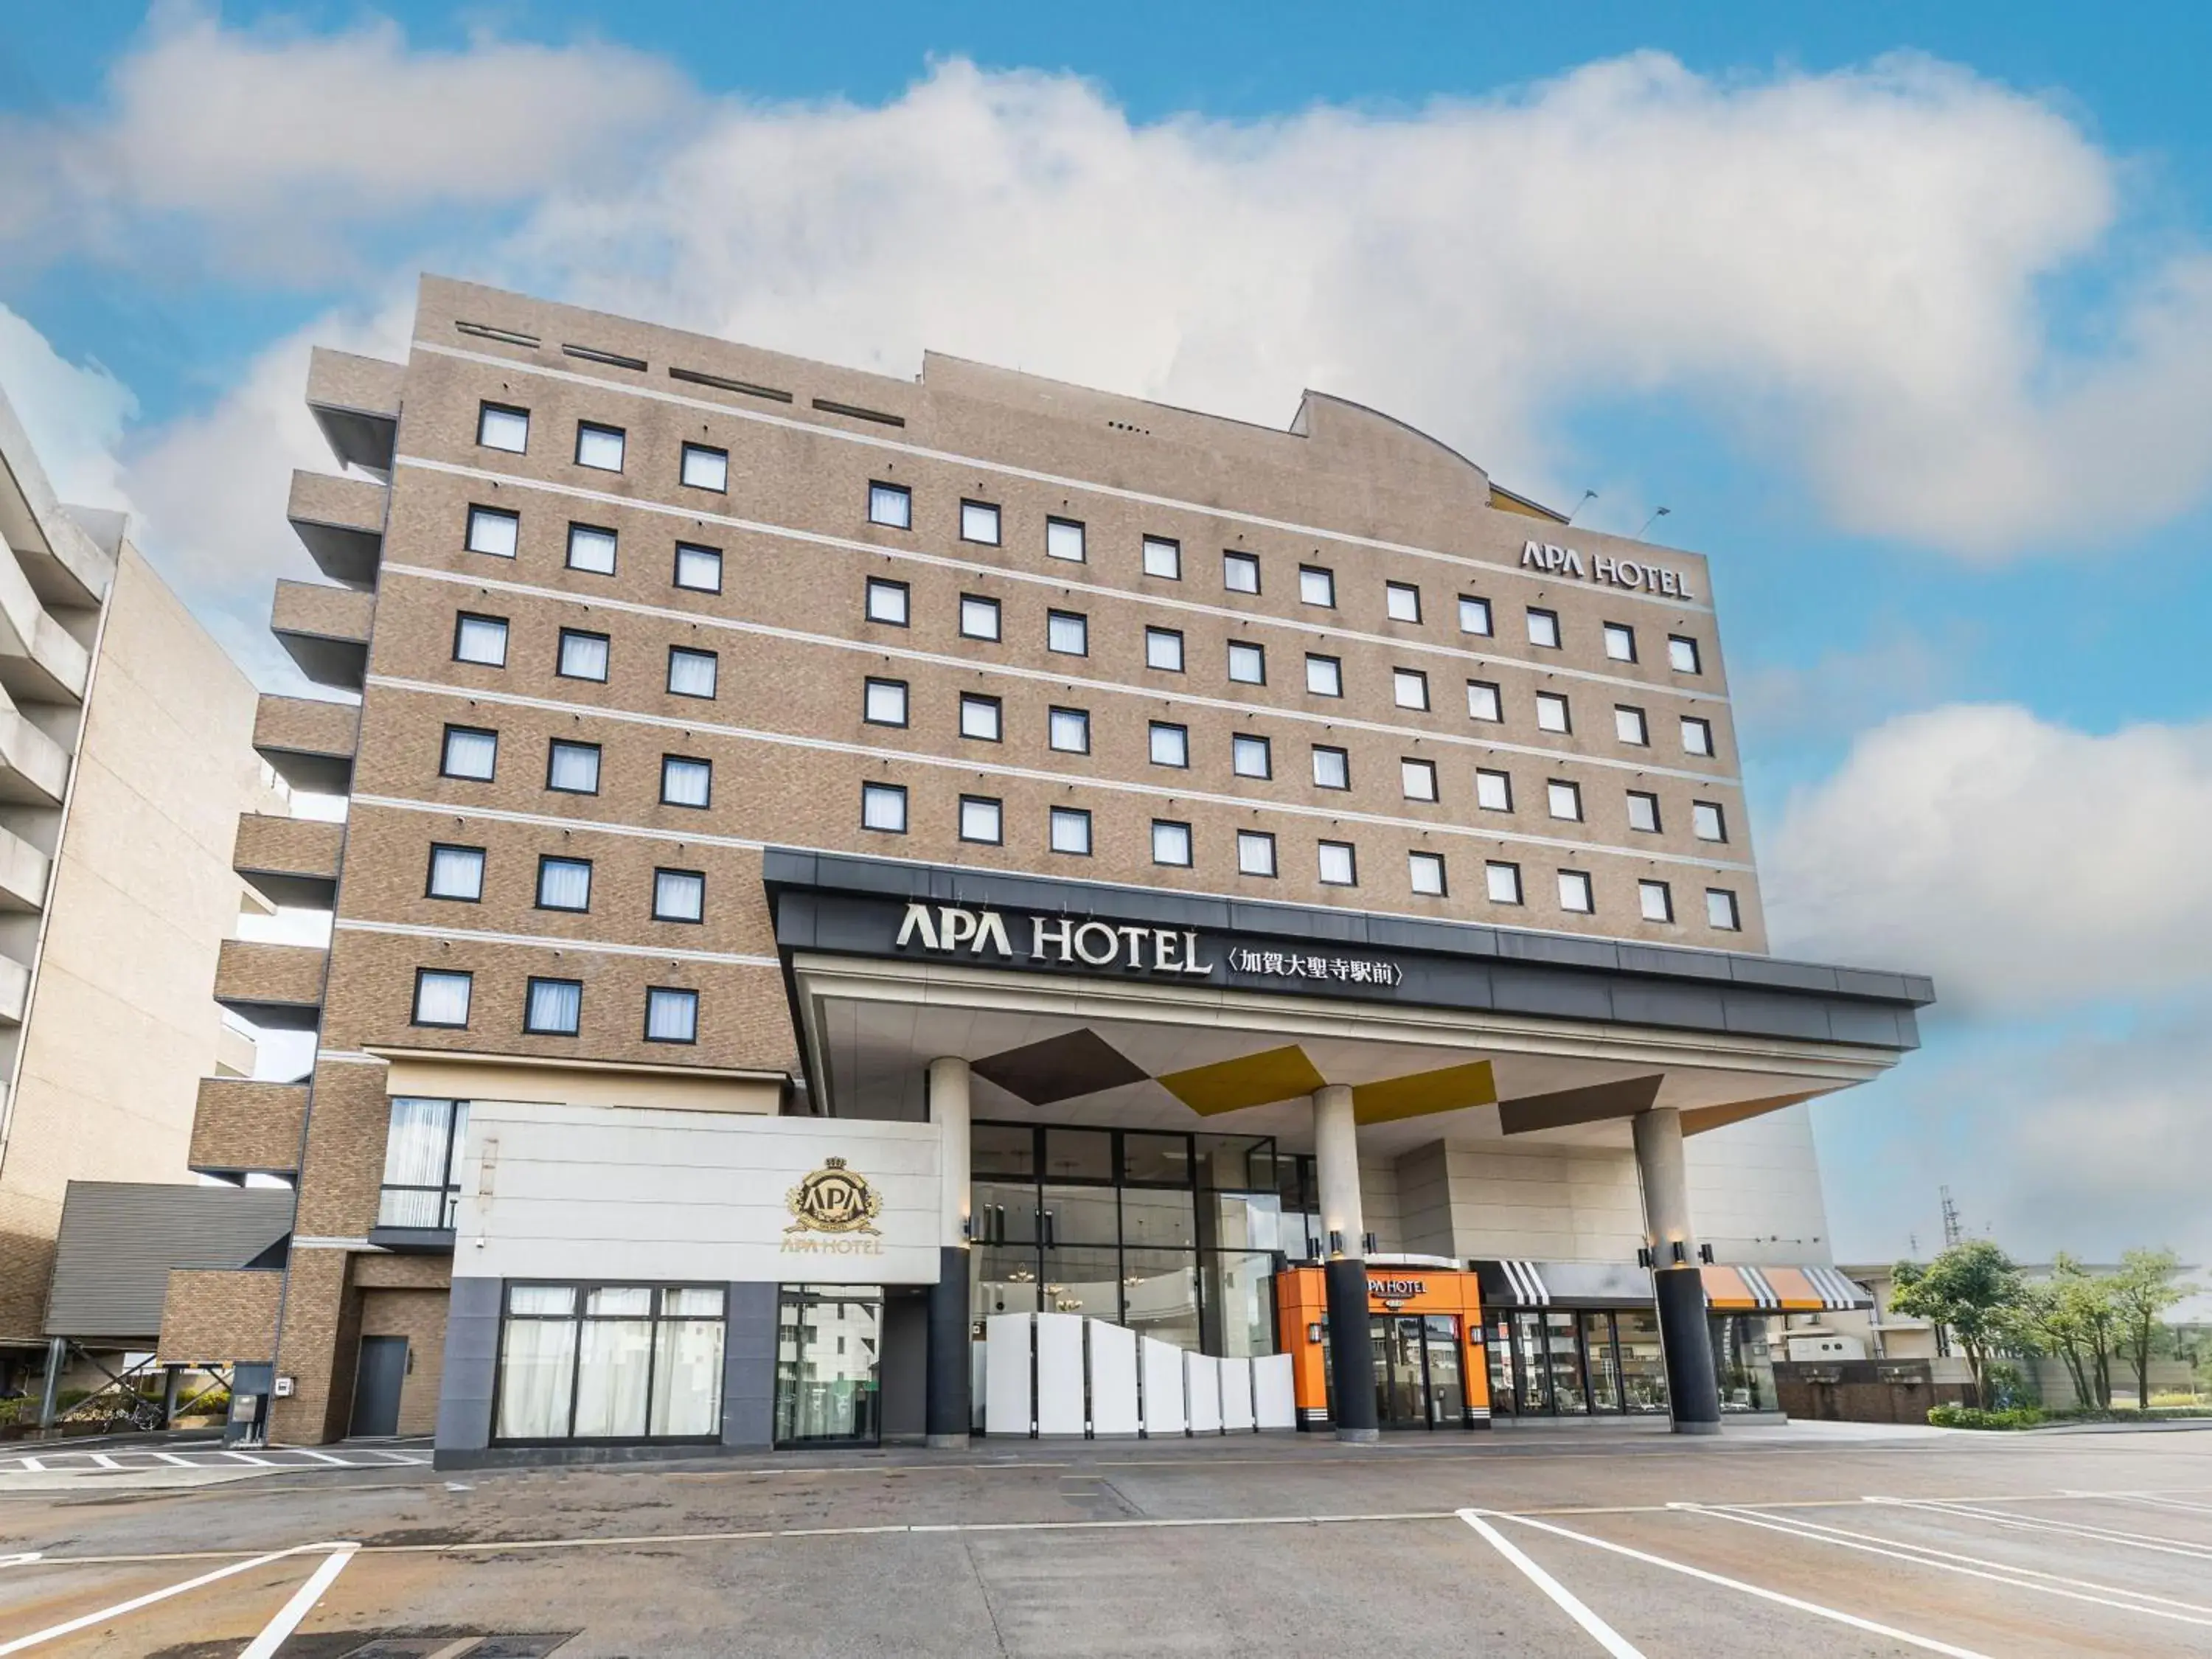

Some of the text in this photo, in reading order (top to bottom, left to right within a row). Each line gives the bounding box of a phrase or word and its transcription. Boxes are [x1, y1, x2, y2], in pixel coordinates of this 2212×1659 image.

[1522, 540, 1694, 599] APA HOTEL
[896, 903, 1214, 974] APA HOTEL
[803, 1187, 864, 1210] APA
[780, 1239, 884, 1255] APA HOTEL
[1367, 1279, 1427, 1293] PA HOTEL
